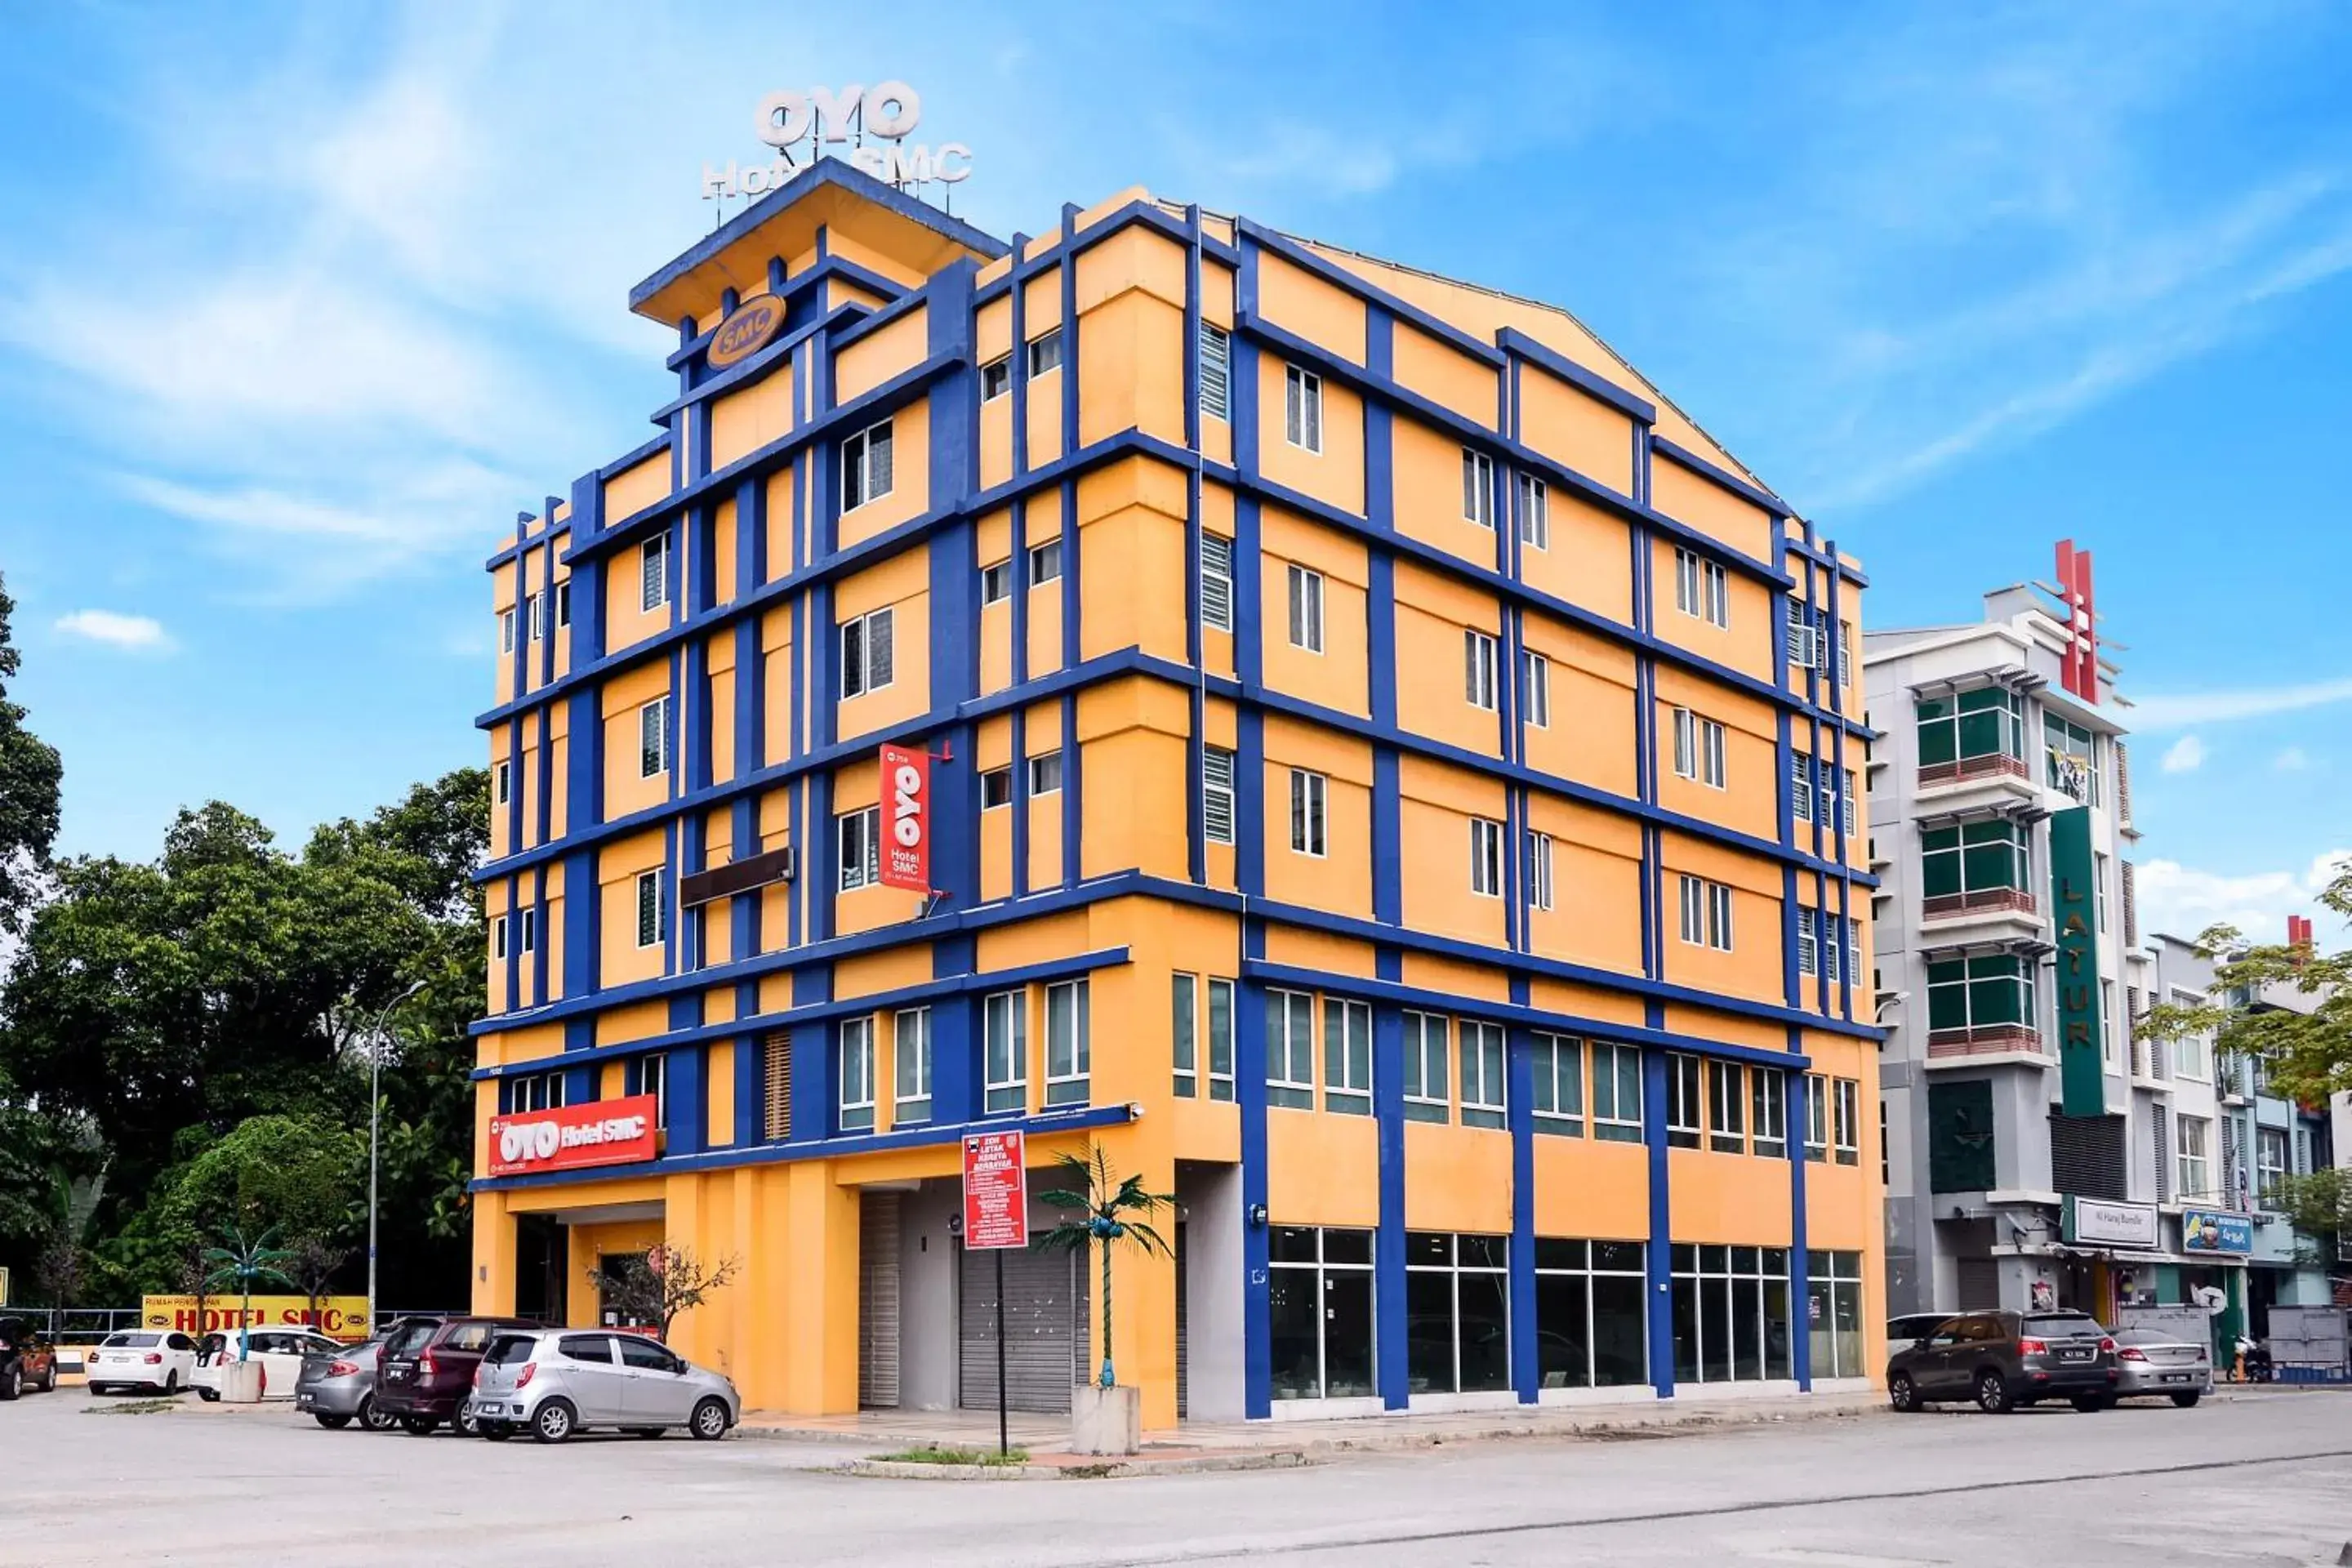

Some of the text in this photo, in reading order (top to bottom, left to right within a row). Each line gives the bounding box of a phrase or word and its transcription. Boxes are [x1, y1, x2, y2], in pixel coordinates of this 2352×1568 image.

[754, 80, 921, 147] OYO
[853, 141, 973, 185] SMC
[721, 308, 769, 354] SMC
[894, 765, 921, 848] OYO
[891, 848, 920, 863] Hotel
[892, 860, 919, 875] SMC
[2063, 878, 2091, 1050] LATUR
[500, 1120, 560, 1163] OYO
[561, 1121, 603, 1148] Hotel
[603, 1116, 646, 1143] SMC
